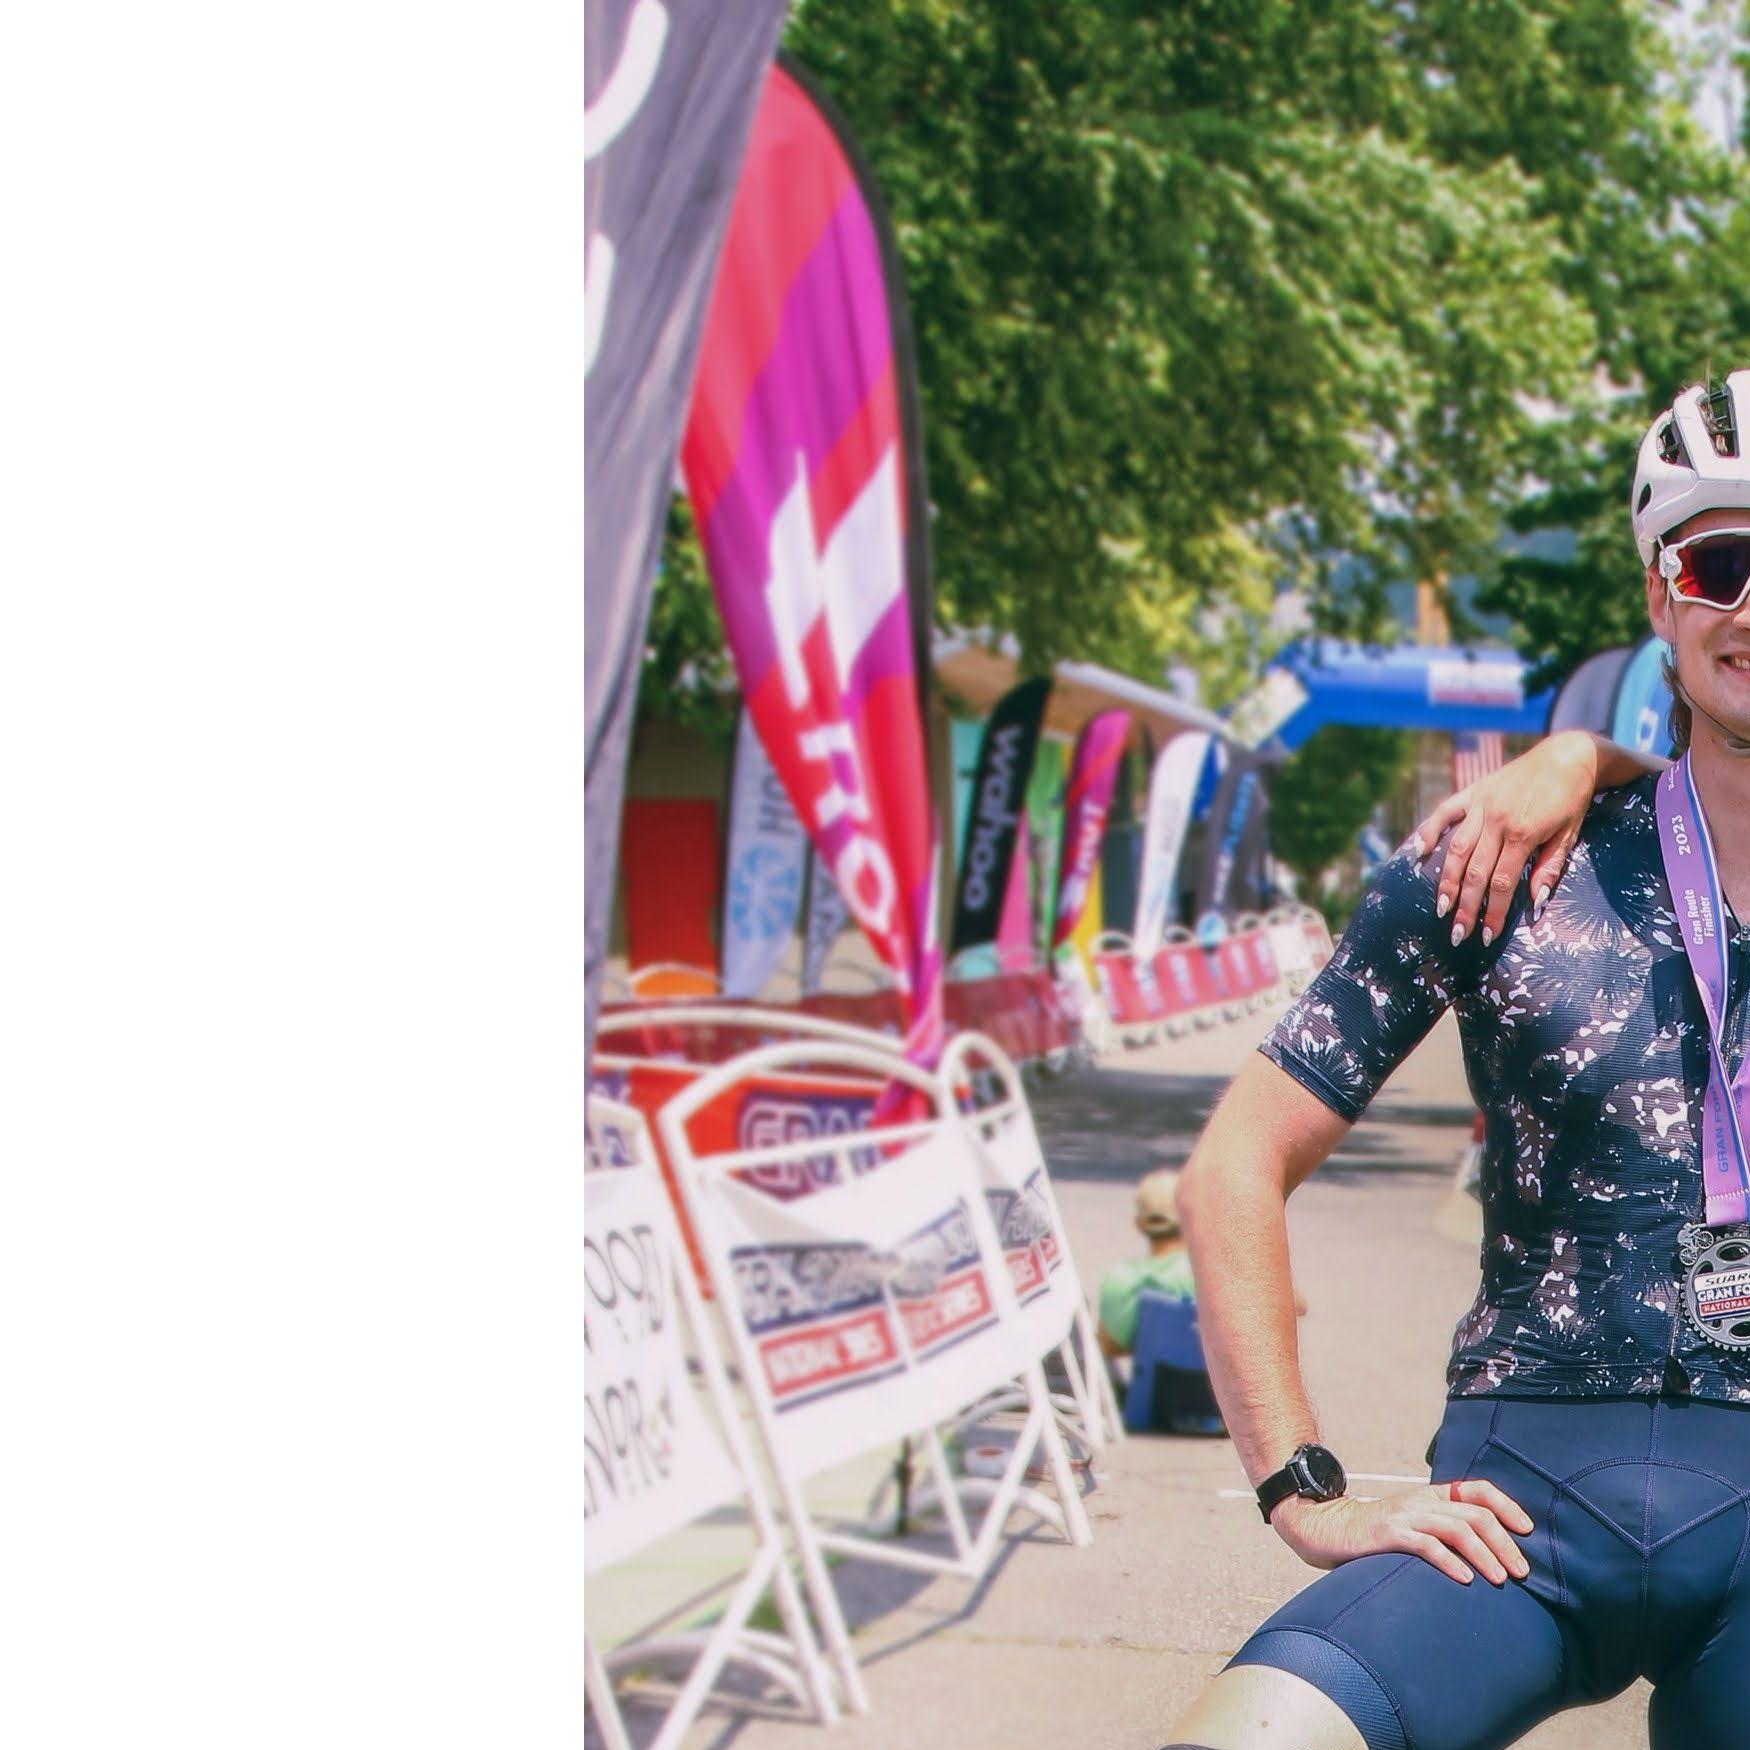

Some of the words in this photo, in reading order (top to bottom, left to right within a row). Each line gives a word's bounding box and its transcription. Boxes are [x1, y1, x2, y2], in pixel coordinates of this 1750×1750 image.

[964, 724, 1023, 910] wahoo
[1671, 814, 1692, 856] 2023
[1684, 888, 1700, 918] Route
[1699, 895, 1715, 937] Finisher
[1690, 919, 1704, 946] Gran
[1715, 1127, 1729, 1173] GRAN
[1697, 1286, 1735, 1302] GRAN
[1703, 1299, 1750, 1313] NATIONAL
